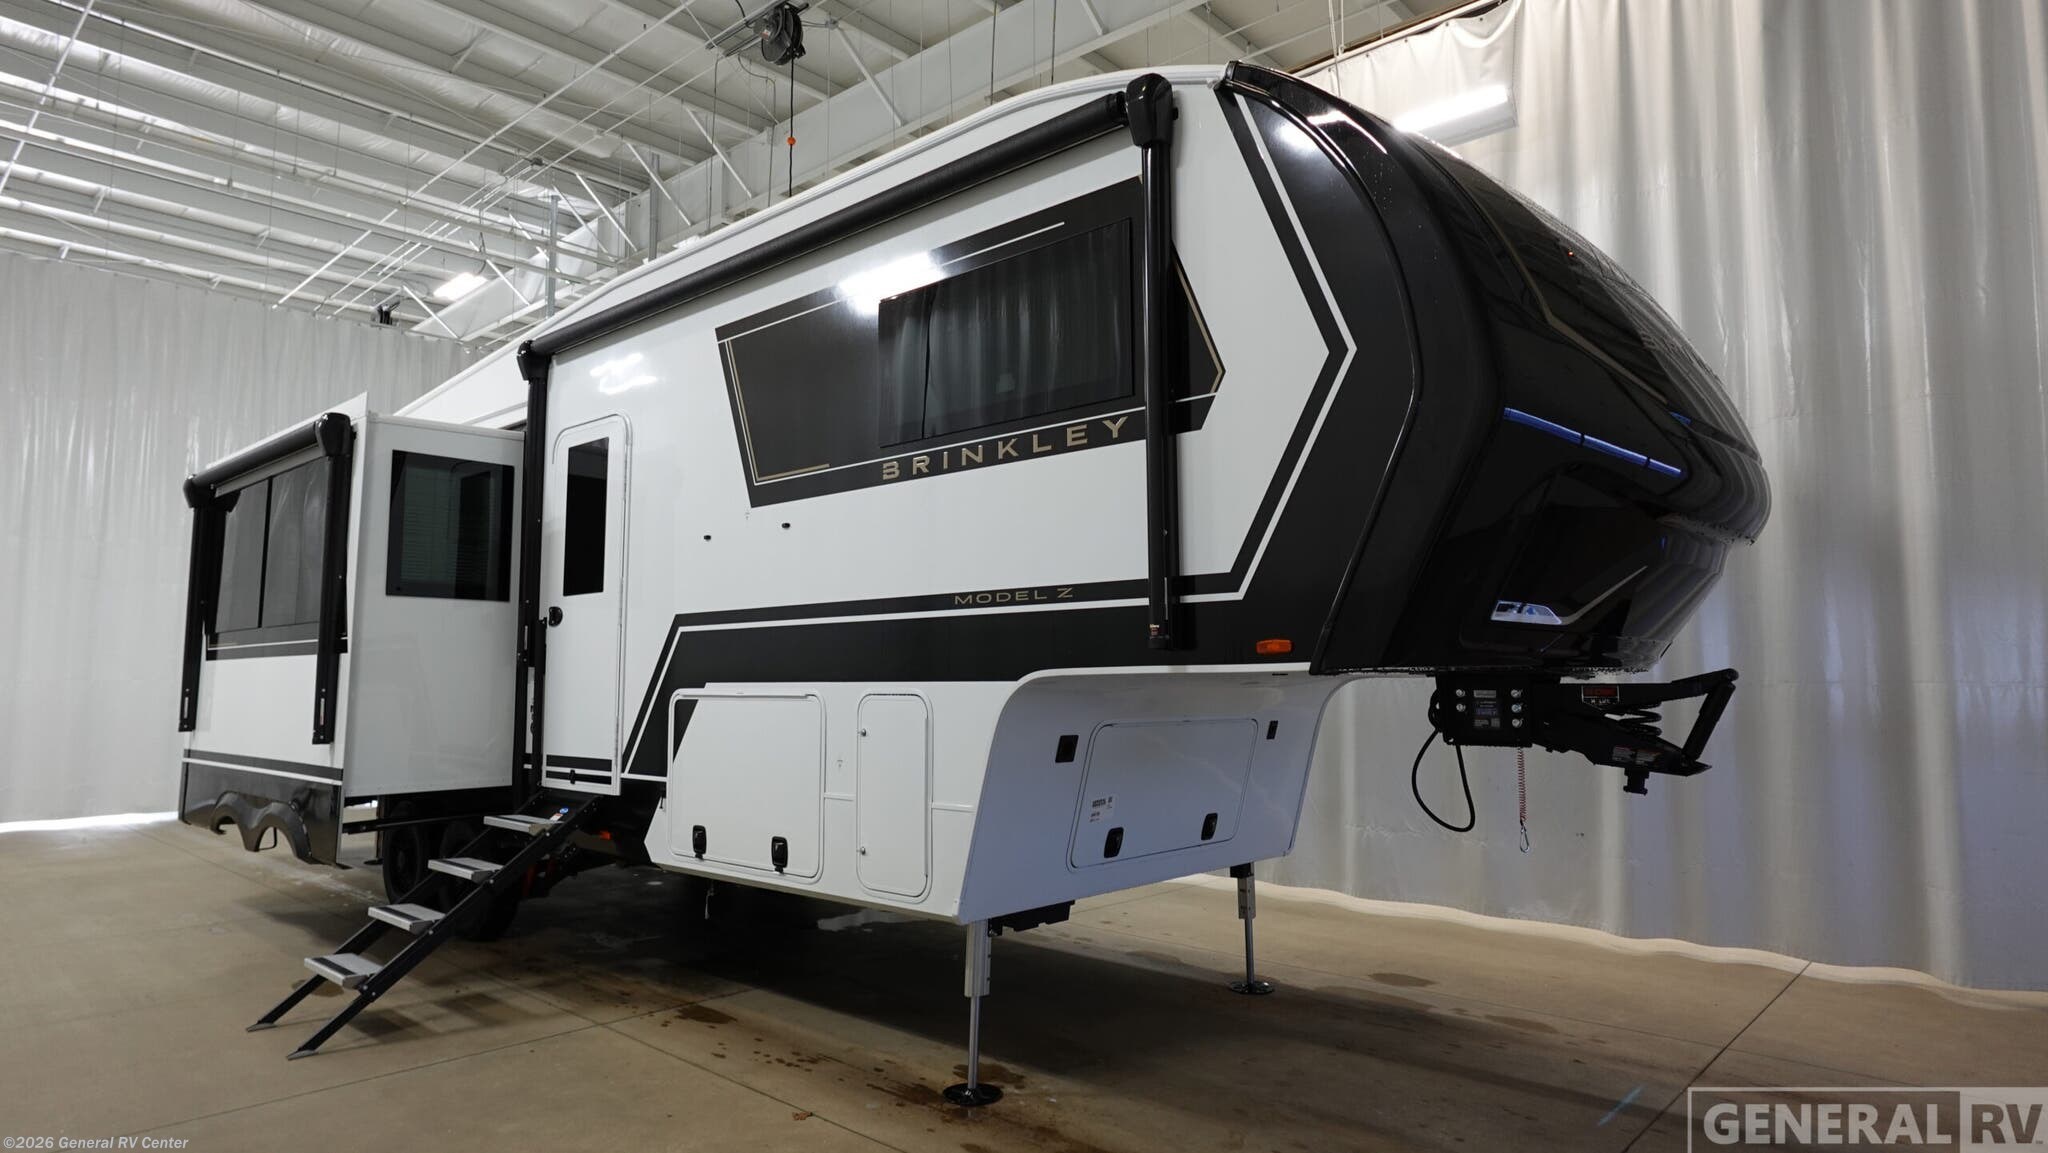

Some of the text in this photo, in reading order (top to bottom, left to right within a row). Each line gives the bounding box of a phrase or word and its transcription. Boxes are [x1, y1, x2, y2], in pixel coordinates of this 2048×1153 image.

[882, 416, 1128, 481] BRINKLEY
[954, 587, 1073, 606] MODEL Z
